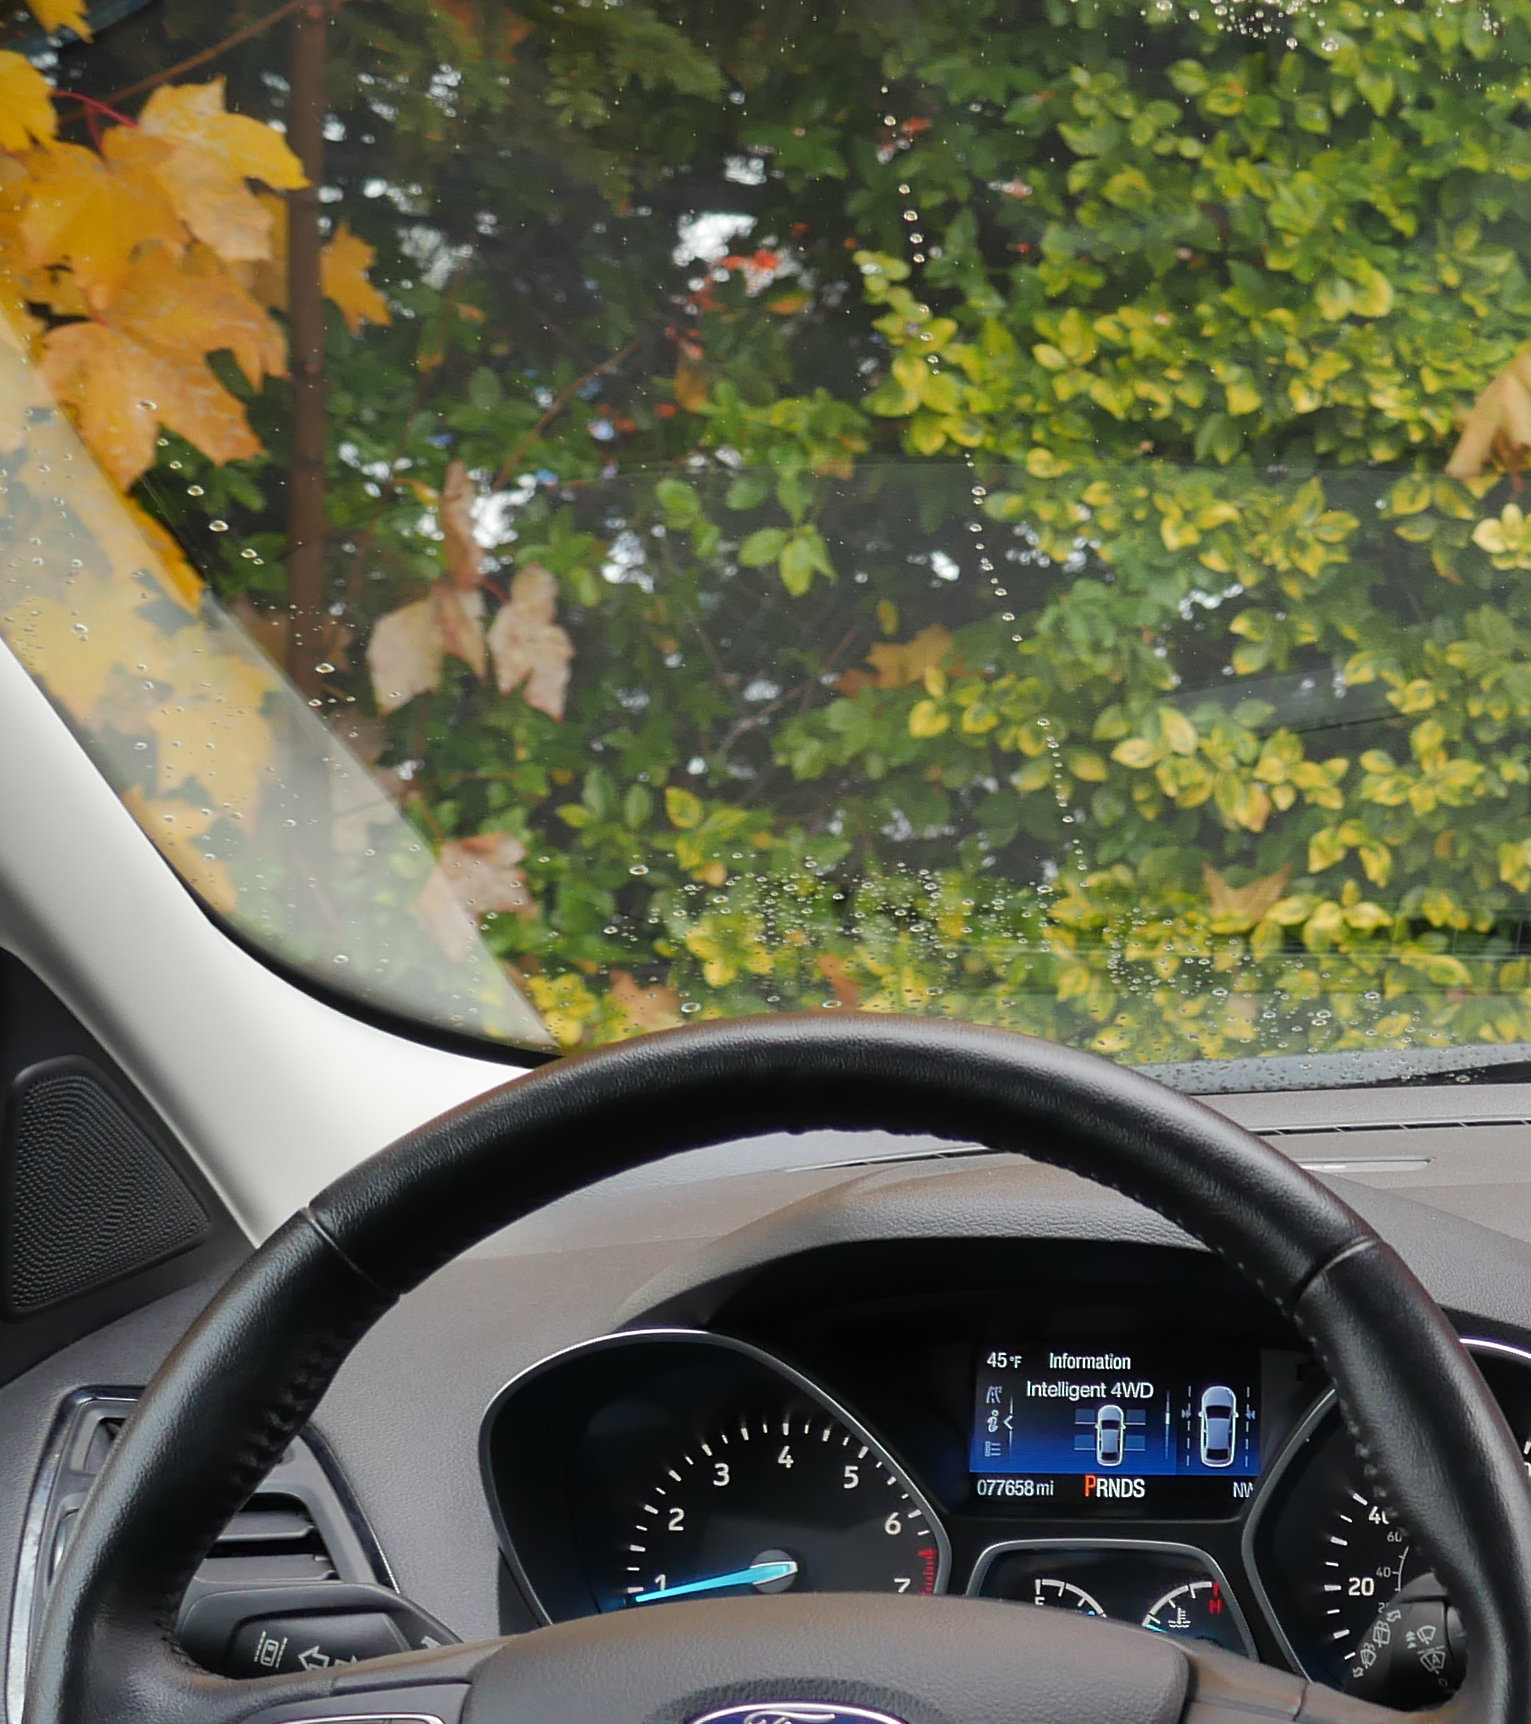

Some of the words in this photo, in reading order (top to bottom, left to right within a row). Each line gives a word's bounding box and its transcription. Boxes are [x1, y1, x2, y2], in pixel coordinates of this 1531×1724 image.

[1049, 1352, 1132, 1370] Information
[1026, 1380, 1107, 1402] Intelligent
[1110, 1381, 1155, 1400] 4WD
[777, 1445, 795, 1469] 4
[712, 1462, 731, 1488] 3
[843, 1465, 860, 1490] 5
[1084, 1474, 1146, 1499] PRNDS
[977, 1479, 1035, 1497] 077658
[667, 1507, 686, 1533] 2
[884, 1511, 903, 1536] 6
[1375, 1566, 1392, 1579] 40
[1348, 1576, 1375, 1597] 20
[1208, 1599, 1223, 1615] H
